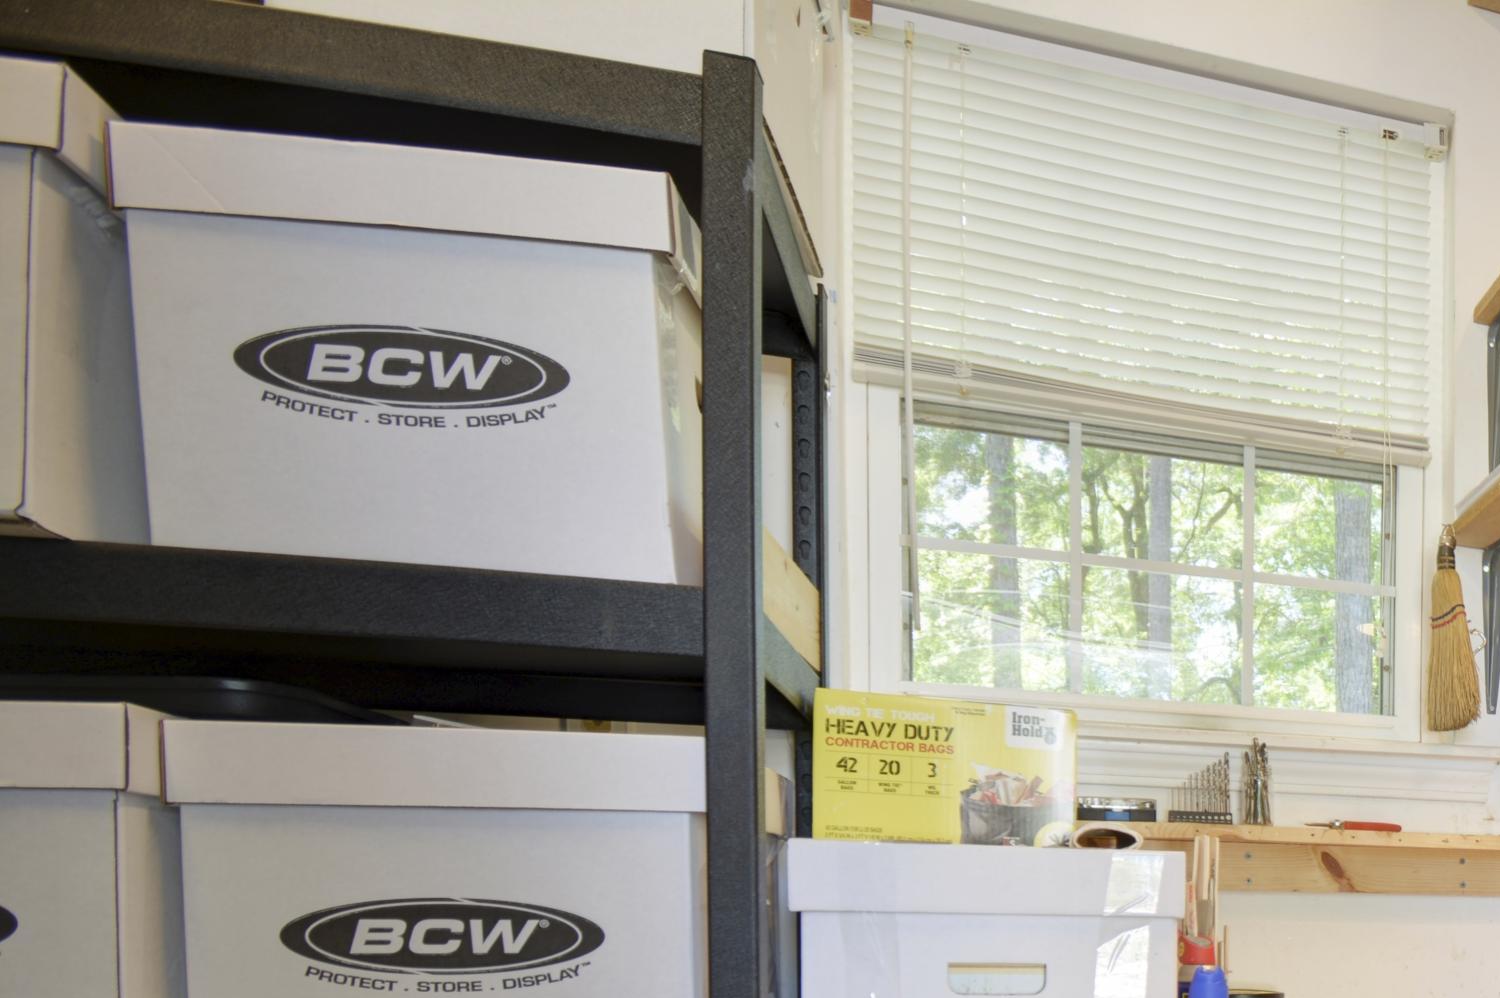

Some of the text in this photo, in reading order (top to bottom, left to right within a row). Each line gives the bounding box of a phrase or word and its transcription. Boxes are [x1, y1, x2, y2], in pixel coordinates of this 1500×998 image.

[307, 343, 501, 391] BCW
[261, 389, 547, 428] PROTECT STORE DISPLAY
[825, 718, 955, 742] HEAVY DUTY
[1012, 711, 1046, 726] Iron-
[1012, 724, 1044, 738] Hold
[825, 736, 955, 755] CONTRACTOR BAGS
[836, 756, 938, 778] 42 20 3
[348, 918, 540, 956] BCW
[305, 964, 582, 993] PROTECT STORE DISPLAY
